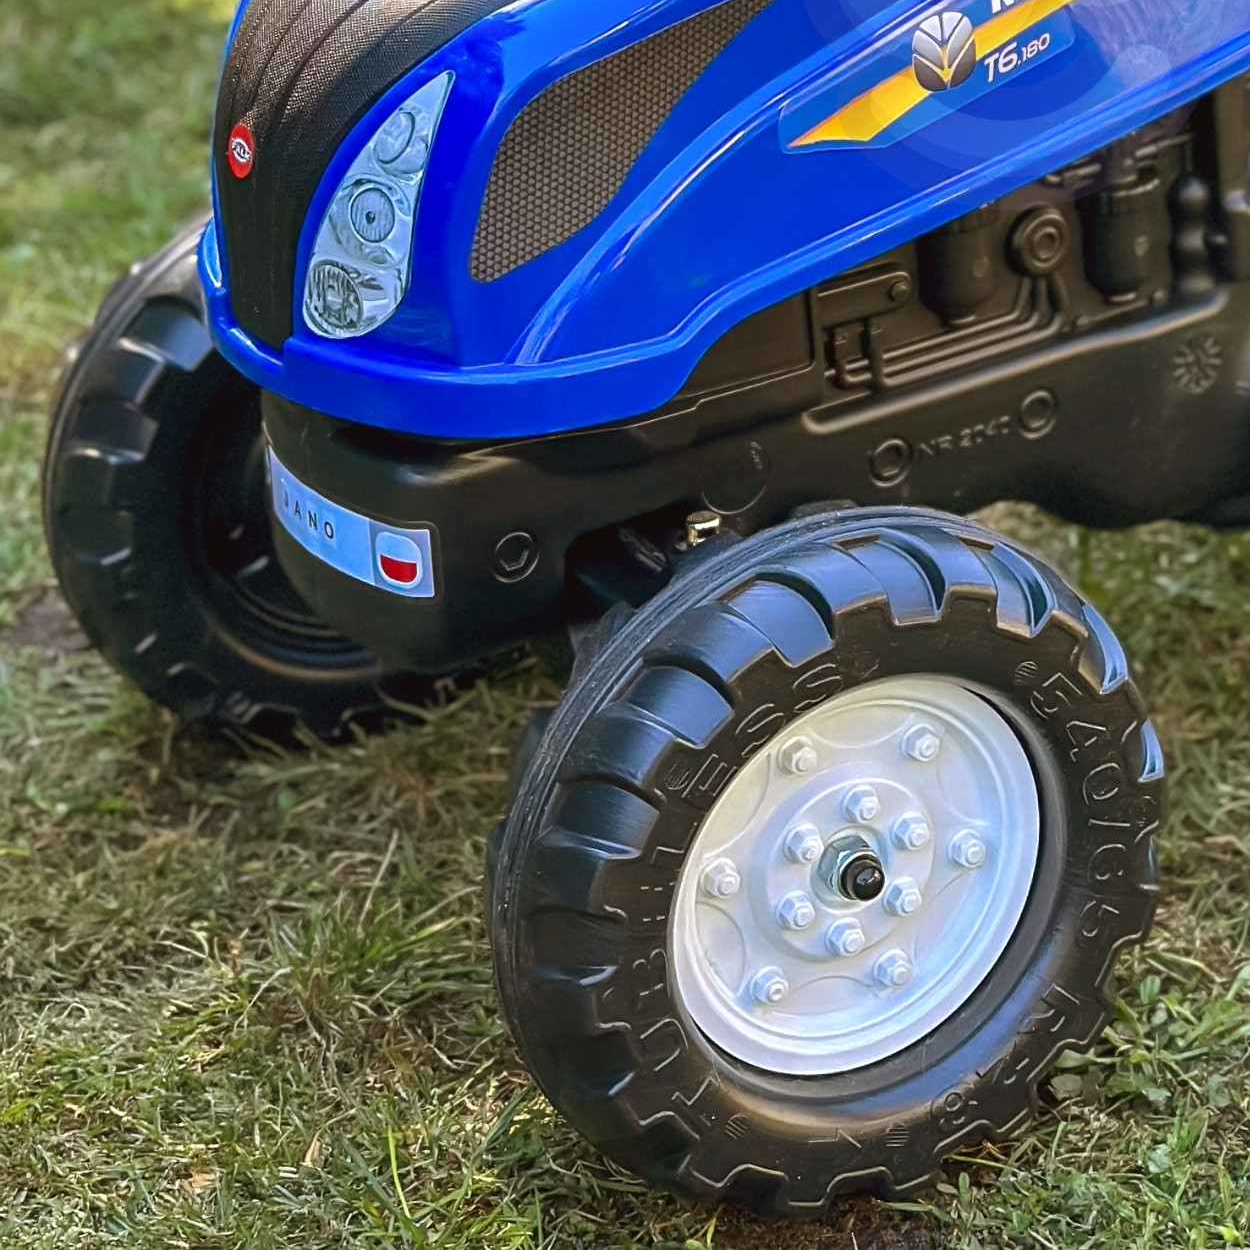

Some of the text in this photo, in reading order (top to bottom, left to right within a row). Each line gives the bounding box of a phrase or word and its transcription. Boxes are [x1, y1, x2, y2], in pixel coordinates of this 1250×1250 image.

[984, 32, 1051, 84] T6.180
[283, 488, 335, 540] JANO
[1029, 672, 1131, 942] 540/65
